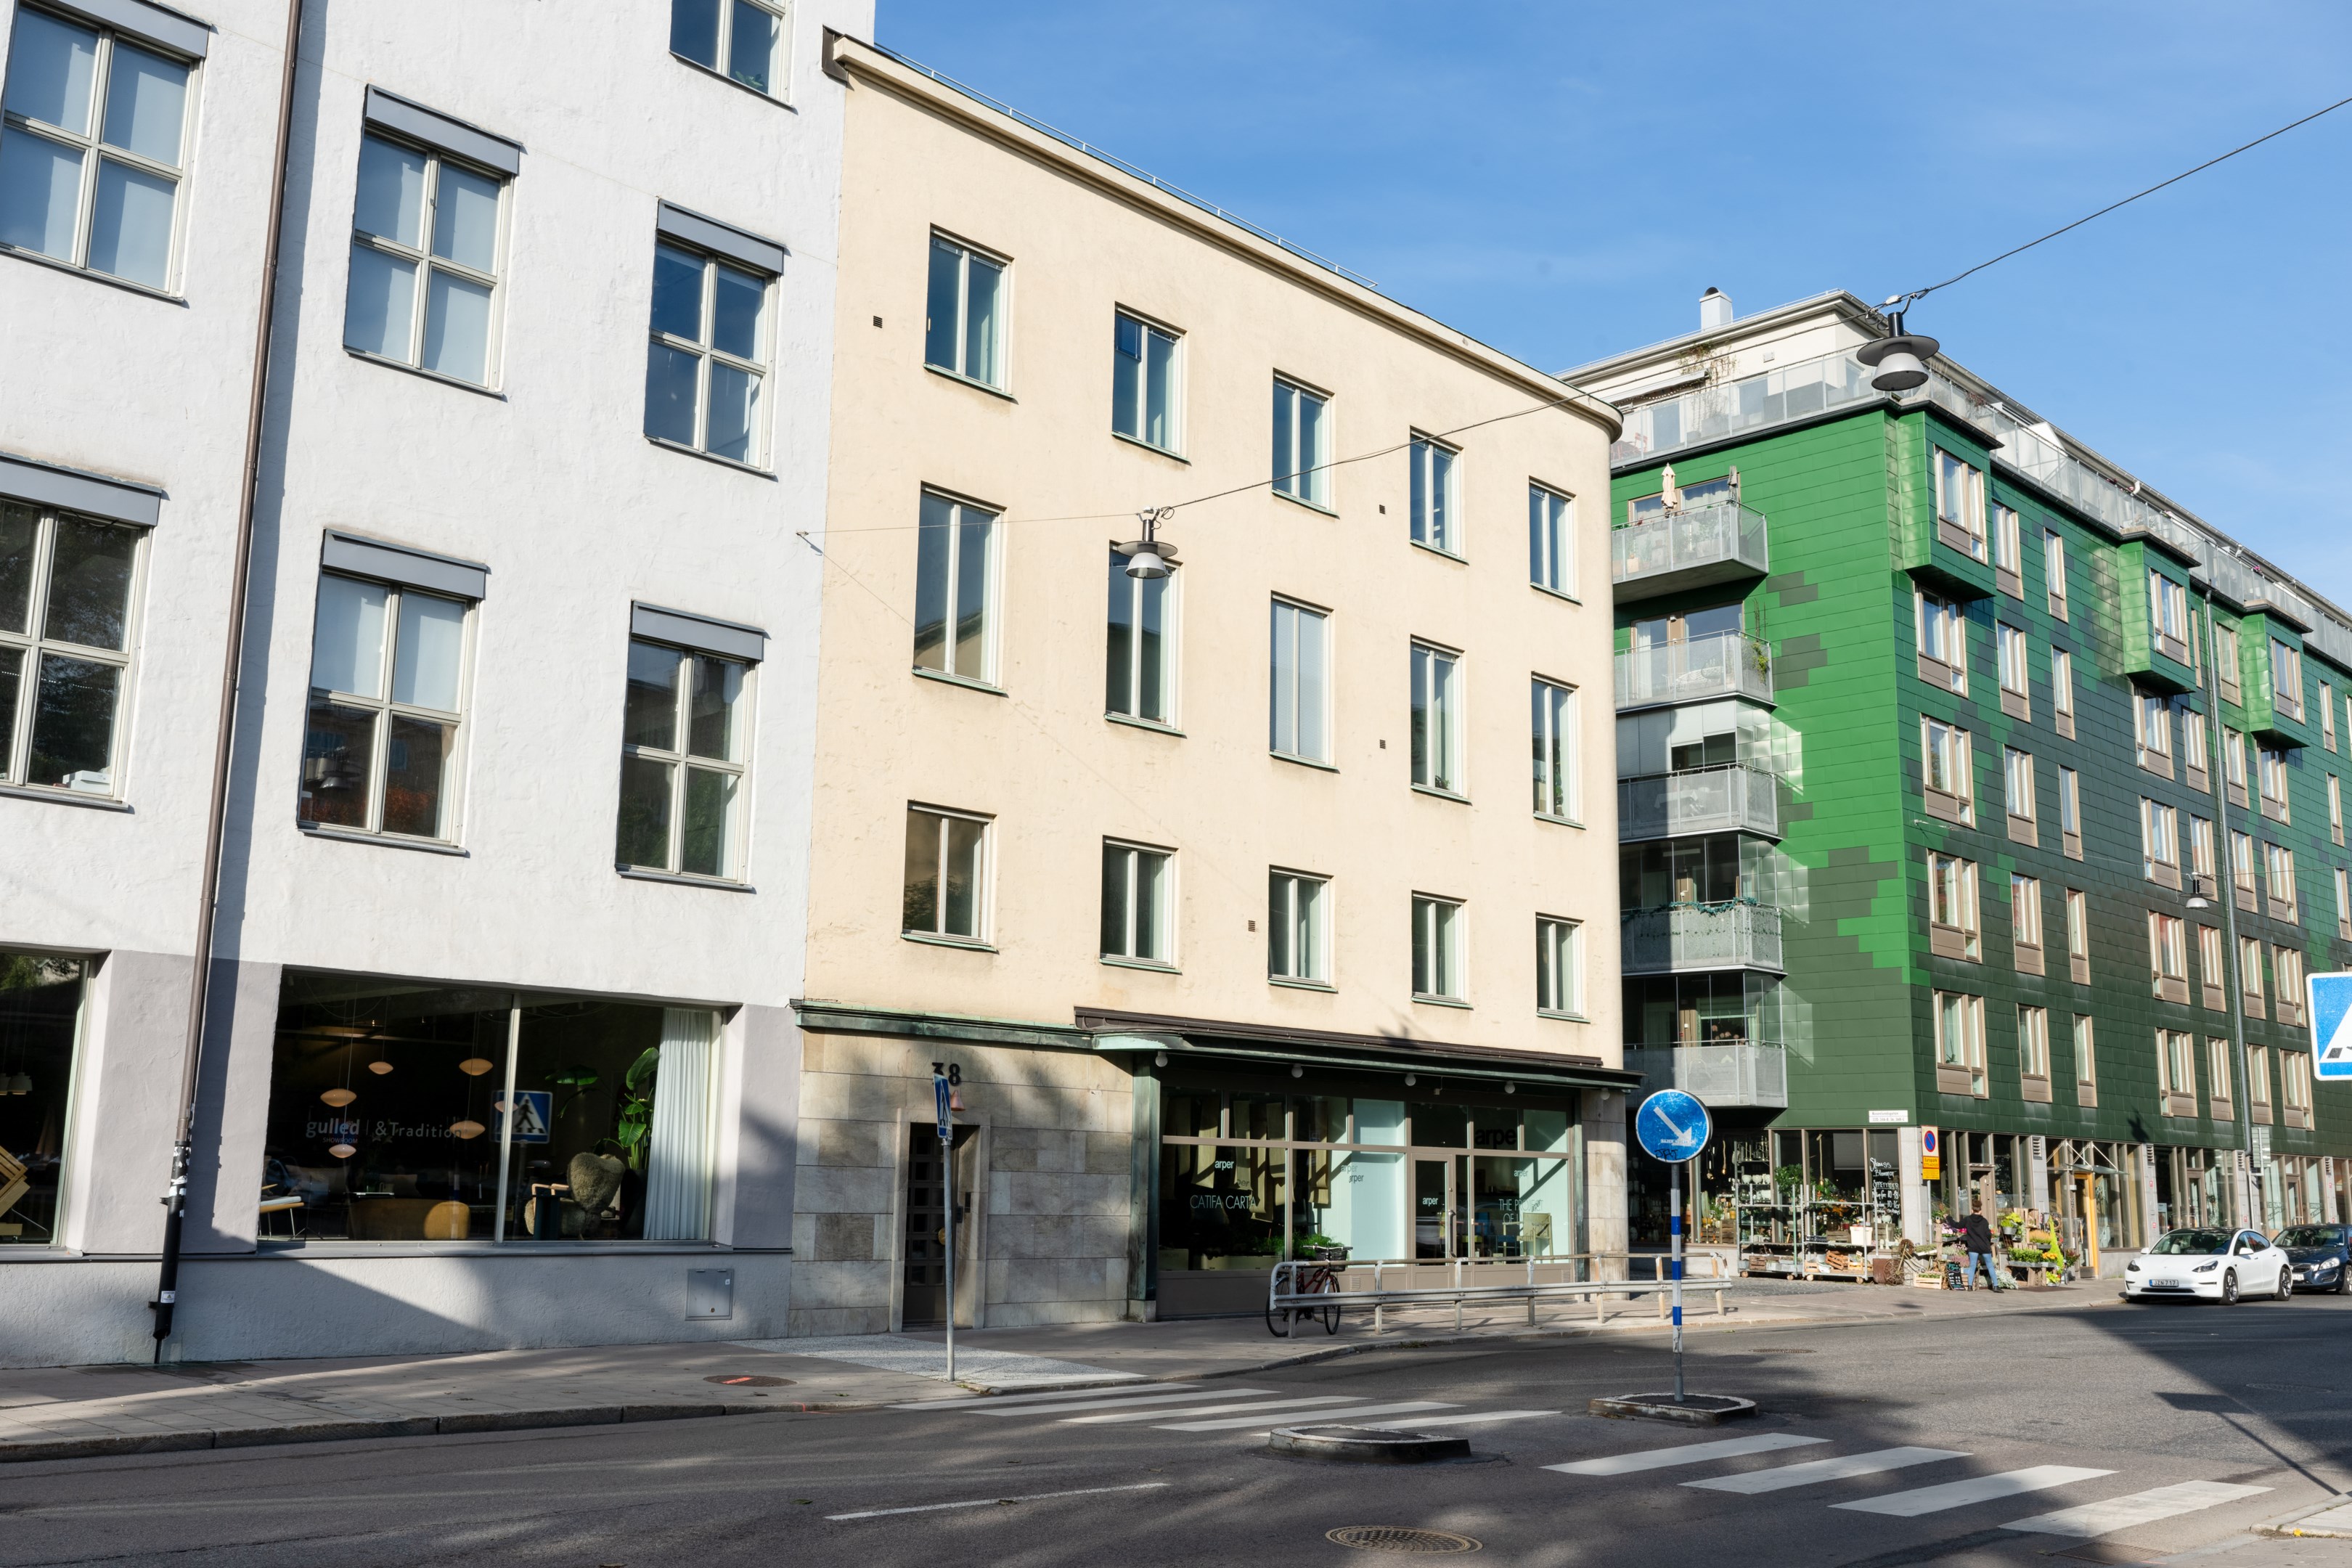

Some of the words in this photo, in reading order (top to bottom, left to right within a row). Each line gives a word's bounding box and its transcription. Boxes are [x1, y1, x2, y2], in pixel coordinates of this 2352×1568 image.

[306, 1118, 360, 1138] gulled
[1475, 1129, 1516, 1149] arpe
[1214, 1161, 1234, 1171] arper
[1190, 1194, 1222, 1209] CATIFA
[1225, 1195, 1257, 1209] CARTA
[1422, 1197, 1439, 1207] arper
[1498, 1199, 1512, 1211] THE
